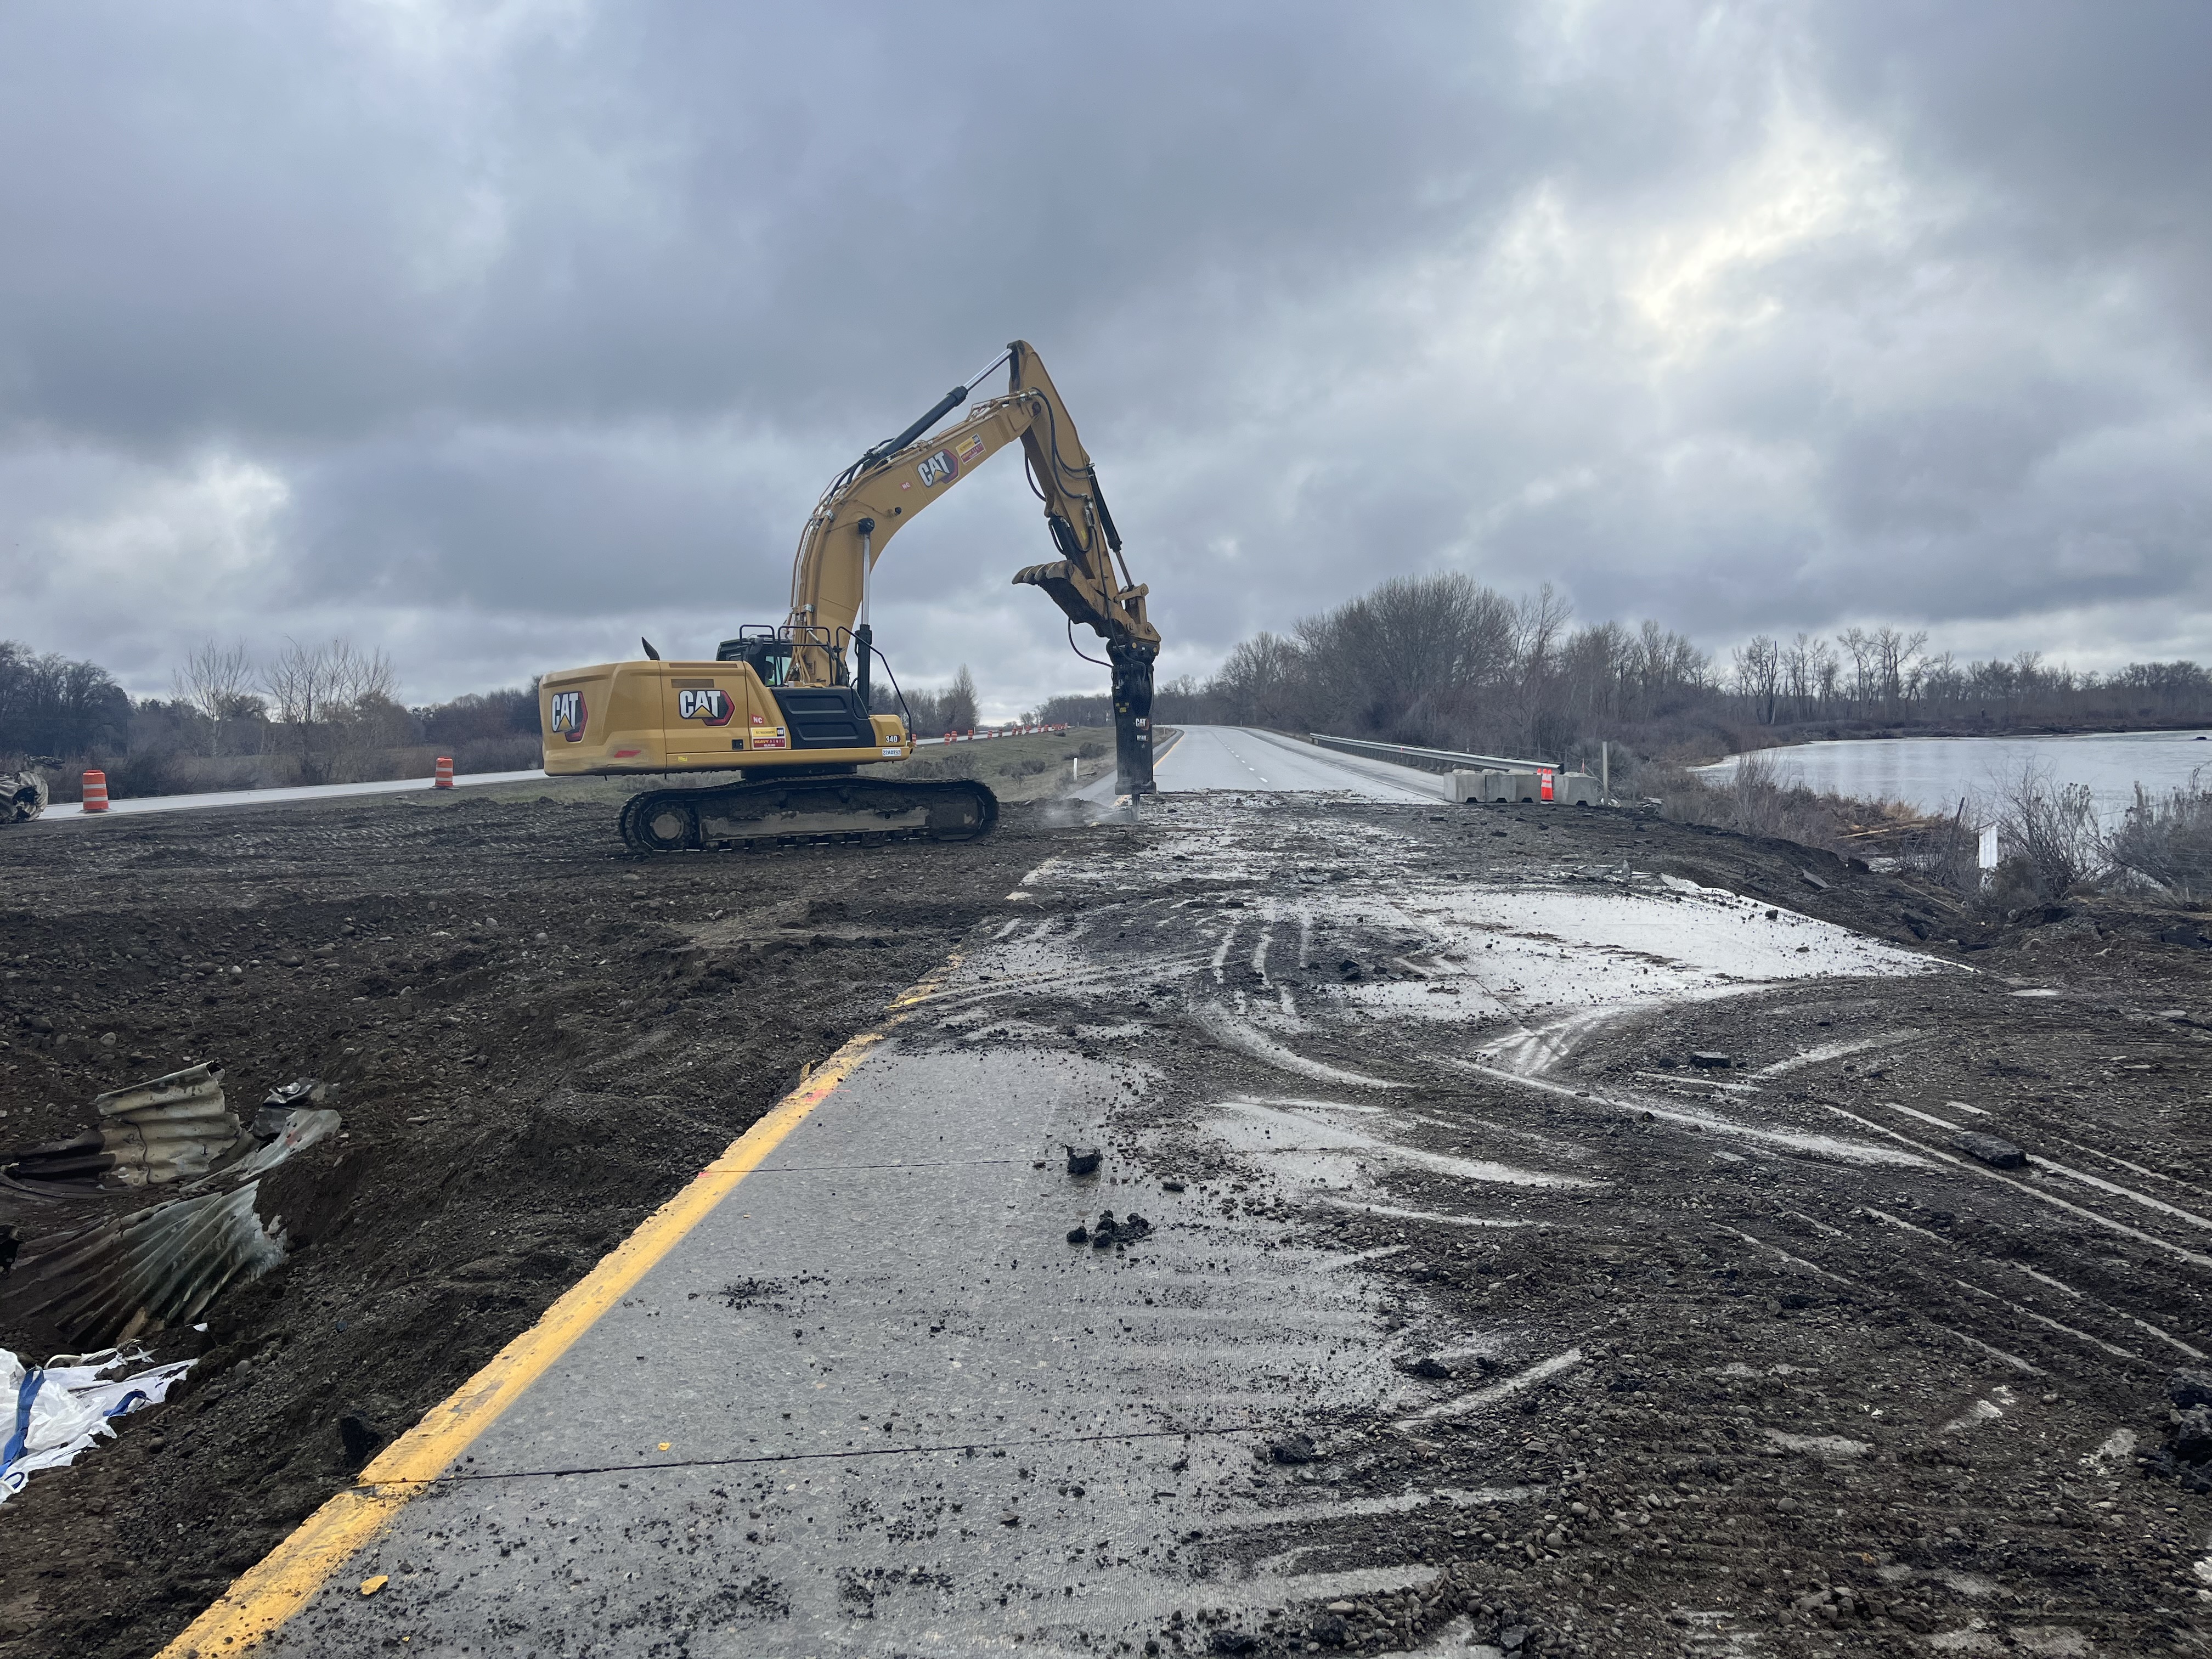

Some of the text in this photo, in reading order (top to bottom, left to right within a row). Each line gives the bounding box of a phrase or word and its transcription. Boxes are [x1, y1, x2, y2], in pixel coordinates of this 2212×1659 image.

[918, 451, 950, 487] CAT
[552, 692, 579, 732] CAT
[679, 691, 720, 718] CAT
[1136, 718, 1146, 727] CAT
